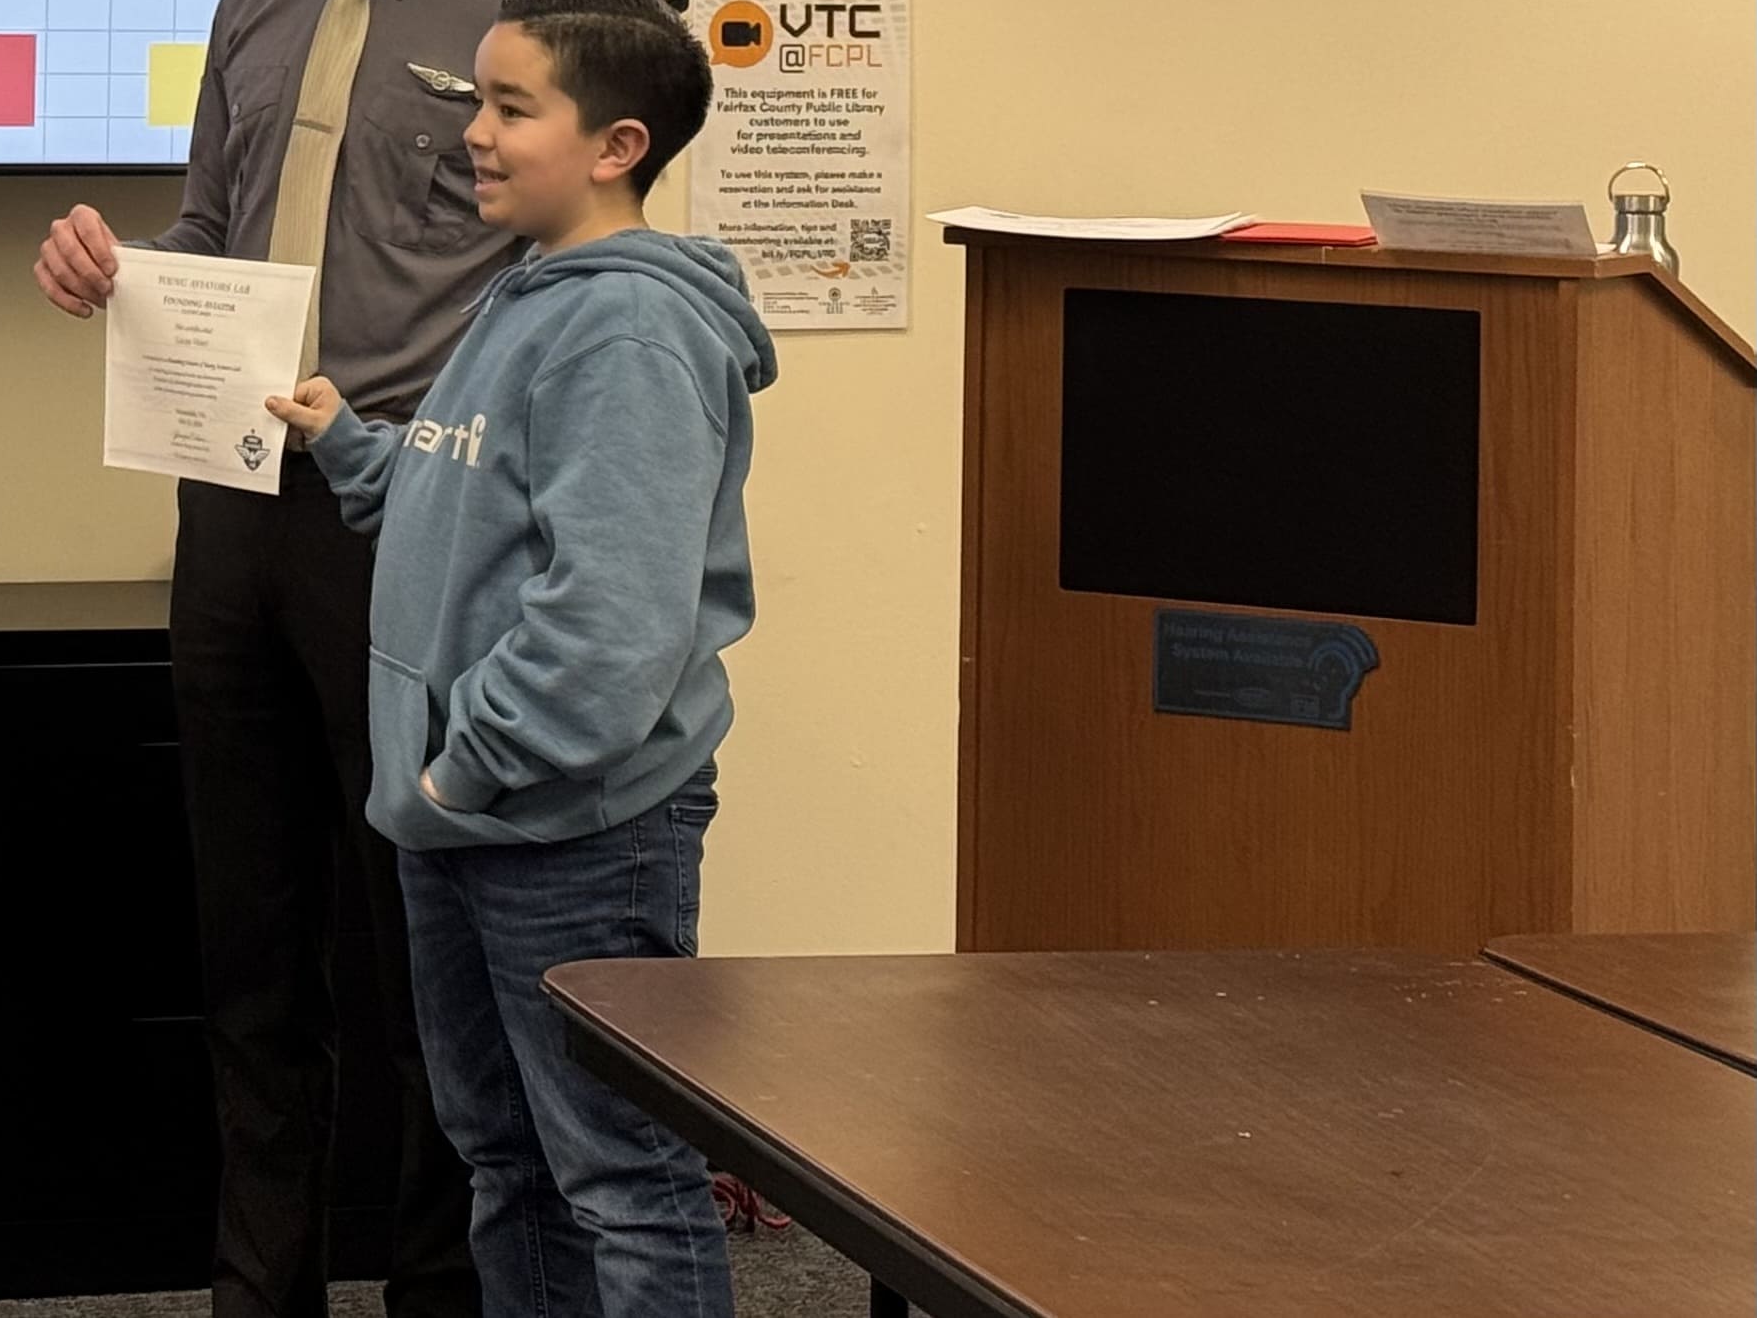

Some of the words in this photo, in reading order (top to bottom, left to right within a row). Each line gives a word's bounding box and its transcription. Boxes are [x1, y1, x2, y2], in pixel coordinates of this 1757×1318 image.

[780, 4, 881, 38] VTC
[779, 44, 882, 73] @FCPL
[724, 88, 747, 99] This
[751, 88, 815, 102] equipment
[818, 88, 827, 99] is
[830, 88, 858, 99] FREE
[862, 88, 878, 99] for
[717, 102, 756, 113] Fairfax
[759, 102, 802, 115] County
[806, 102, 842, 113] Public
[845, 102, 885, 115] Library
[749, 117, 810, 127] customers
[814, 117, 826, 127] to
[829, 119, 850, 127] use
[737, 130, 753, 140] for
[756, 130, 837, 142] presentations
[839, 130, 861, 140] and
[731, 143, 763, 154] video
[720, 169, 732, 179] To
[735, 171, 752, 179] use
[754, 169, 772, 179] this
[848, 170, 874, 179] make
[776, 184, 794, 193] and
[815, 184, 829, 193] for
[754, 199, 770, 208] the
